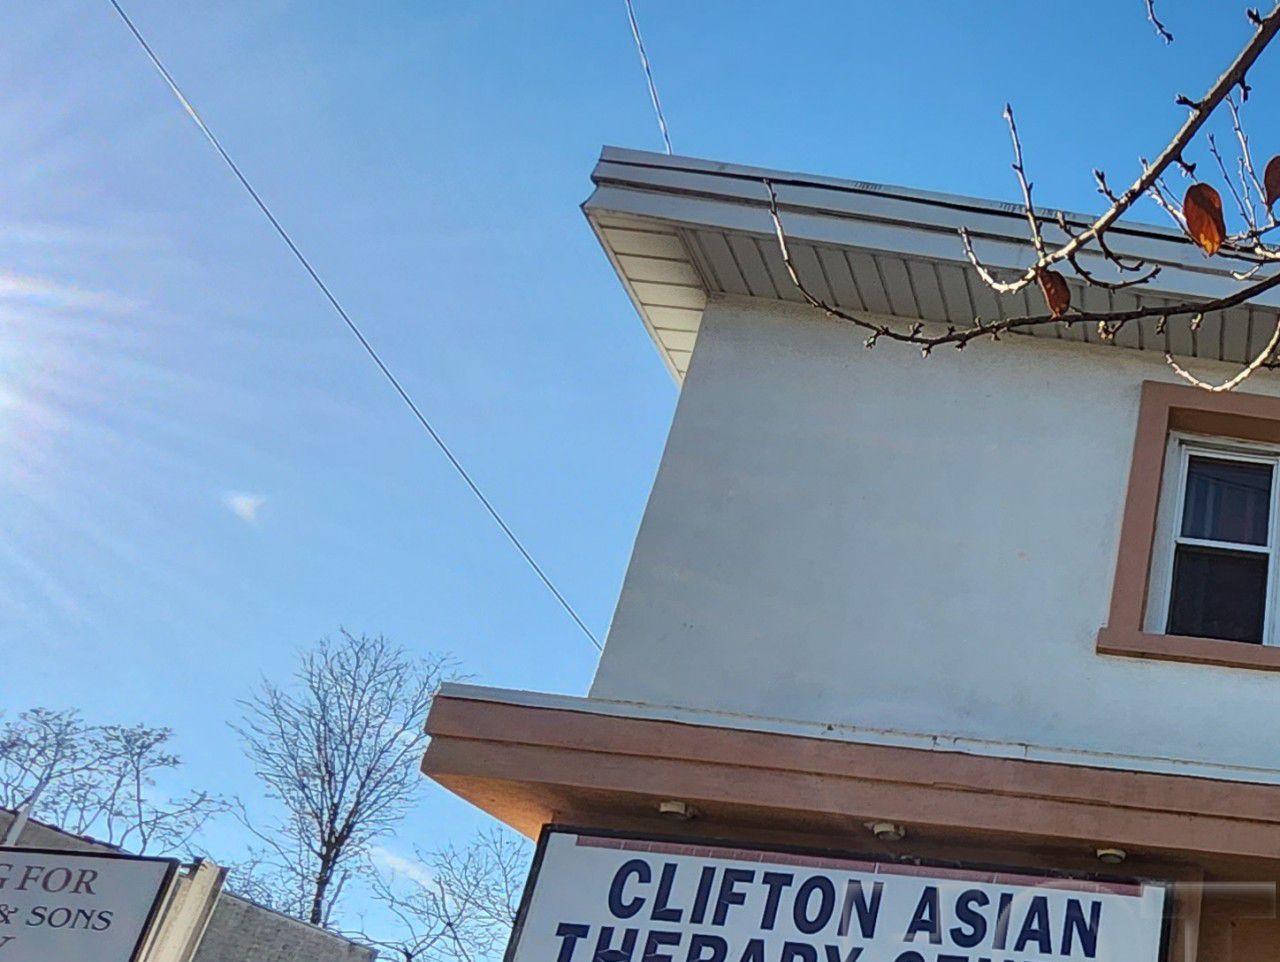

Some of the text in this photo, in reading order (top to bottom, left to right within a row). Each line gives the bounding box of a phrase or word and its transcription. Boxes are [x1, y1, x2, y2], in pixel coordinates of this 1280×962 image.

[15, 865, 98, 895] FOR
[25, 905, 114, 931] SONS
[608, 858, 1103, 959] CLIFTON ASIAN
